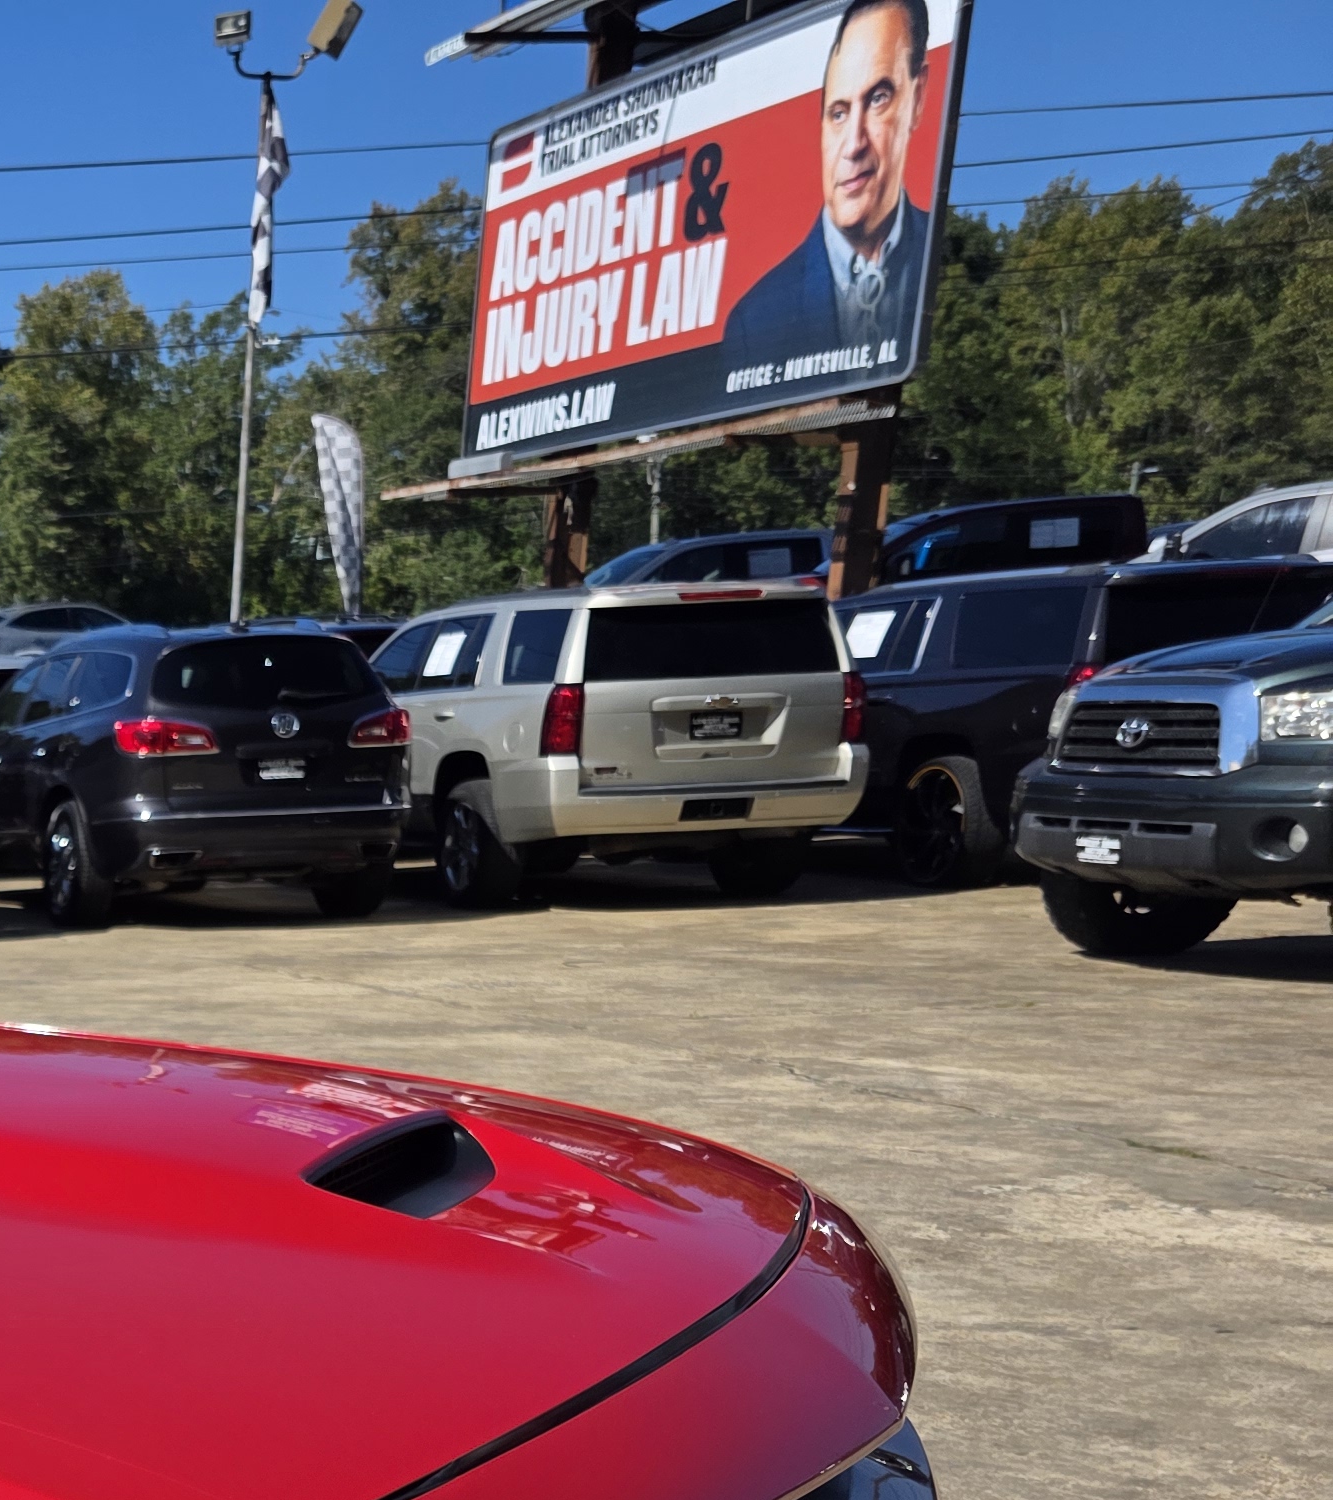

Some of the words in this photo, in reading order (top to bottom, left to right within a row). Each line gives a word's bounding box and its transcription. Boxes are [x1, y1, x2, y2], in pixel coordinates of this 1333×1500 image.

[544, 99, 620, 147] ALEXANDER
[623, 55, 718, 114] SHUNNARAH
[540, 147, 576, 178] TRIAL
[578, 108, 659, 167] ATTORNEYS
[489, 156, 684, 302] ACCIDENT
[684, 142, 730, 242] &
[481, 268, 626, 386] INJURY
[626, 237, 728, 347] LAW
[877, 337, 899, 365] AL
[475, 380, 617, 451] ALEXWINS.LAW
